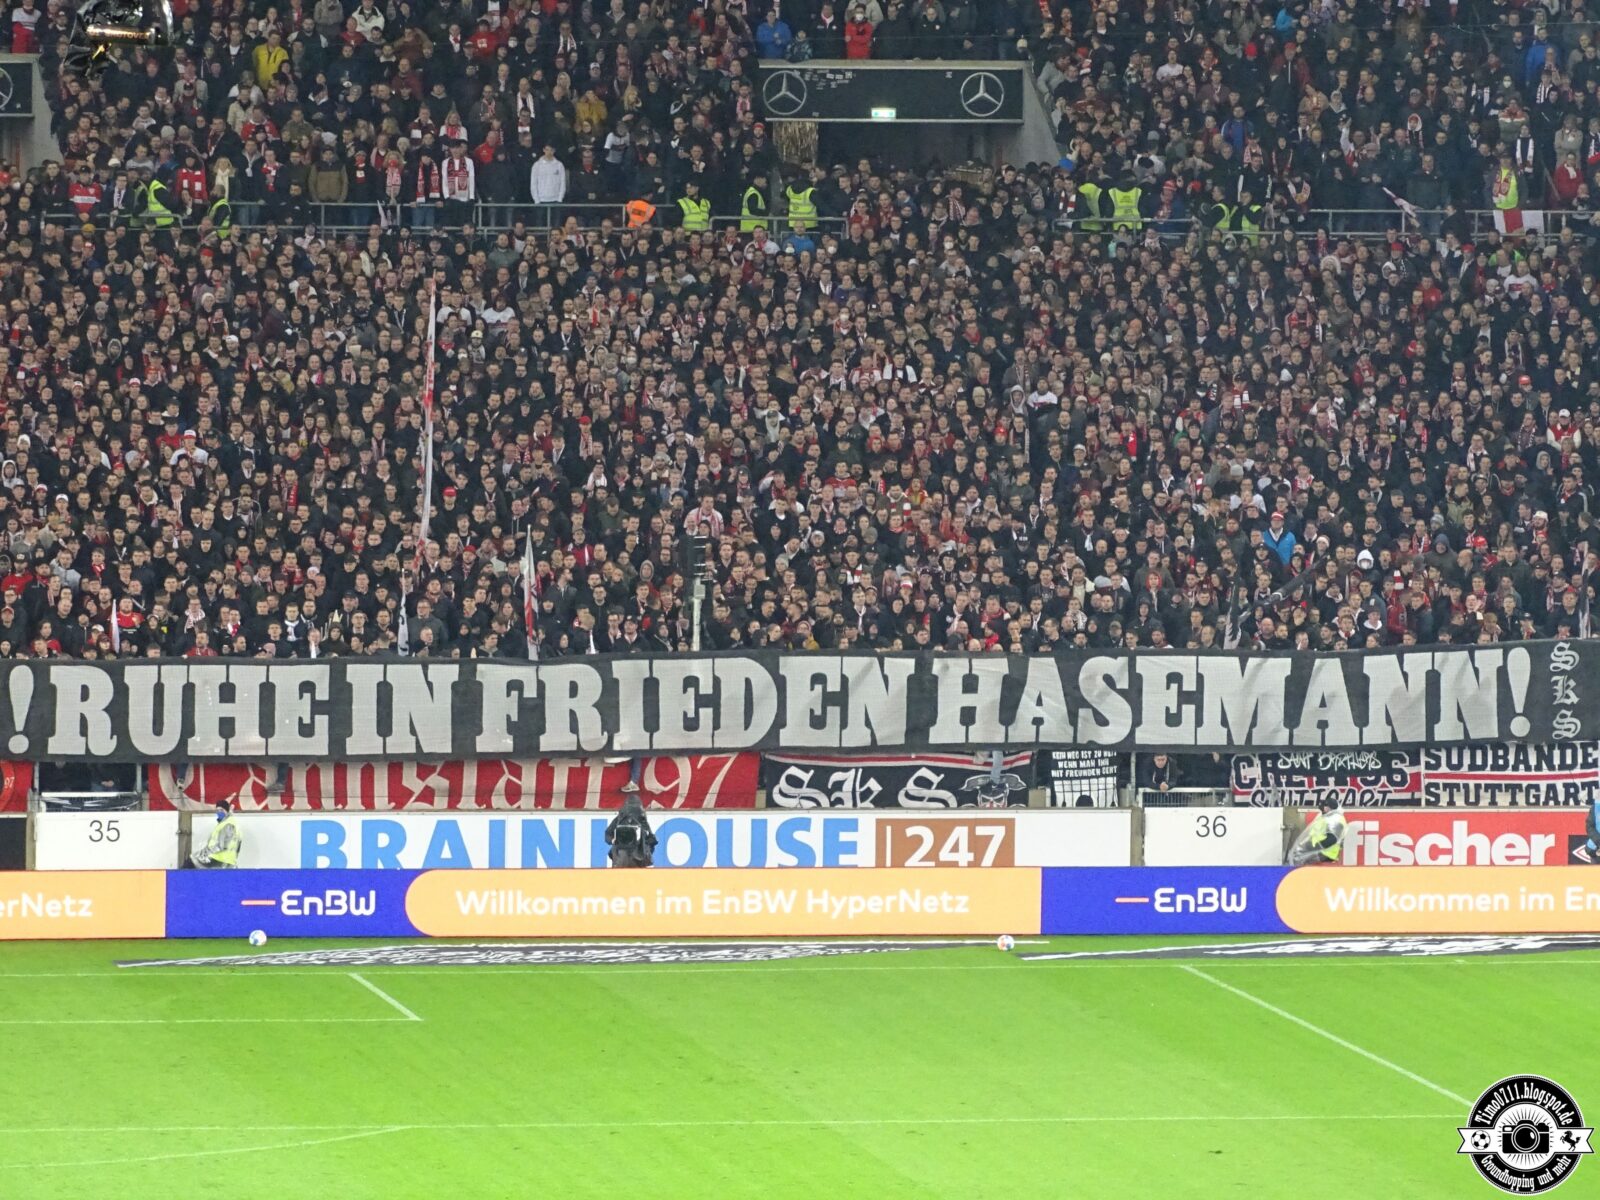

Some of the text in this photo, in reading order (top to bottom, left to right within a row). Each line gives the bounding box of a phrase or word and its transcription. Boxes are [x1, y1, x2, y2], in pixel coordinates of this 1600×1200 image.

[345, 664, 459, 755] IN
[475, 656, 916, 753] FRIEDEN
[929, 646, 1532, 745] HASEMANN!
[1067, 751, 1080, 760] WEG
[1081, 750, 1092, 759] IST
[1079, 759, 1096, 768] MAN
[1051, 769, 1064, 778] MIT
[1065, 768, 1101, 778] FREUNDEN
[1424, 780, 1600, 807] STUTTGART
[89, 819, 121, 842] 35
[1195, 815, 1228, 838] 36
[904, 825, 1006, 867] 247
[1341, 820, 1556, 866] fischer
[280, 889, 376, 916] EnBW
[455, 888, 970, 919] Willkommen im EnBW HyperNetz
[1153, 887, 1248, 913] EnBW
[1324, 887, 1510, 912] Willkommen
[1519, 886, 1555, 911] im
